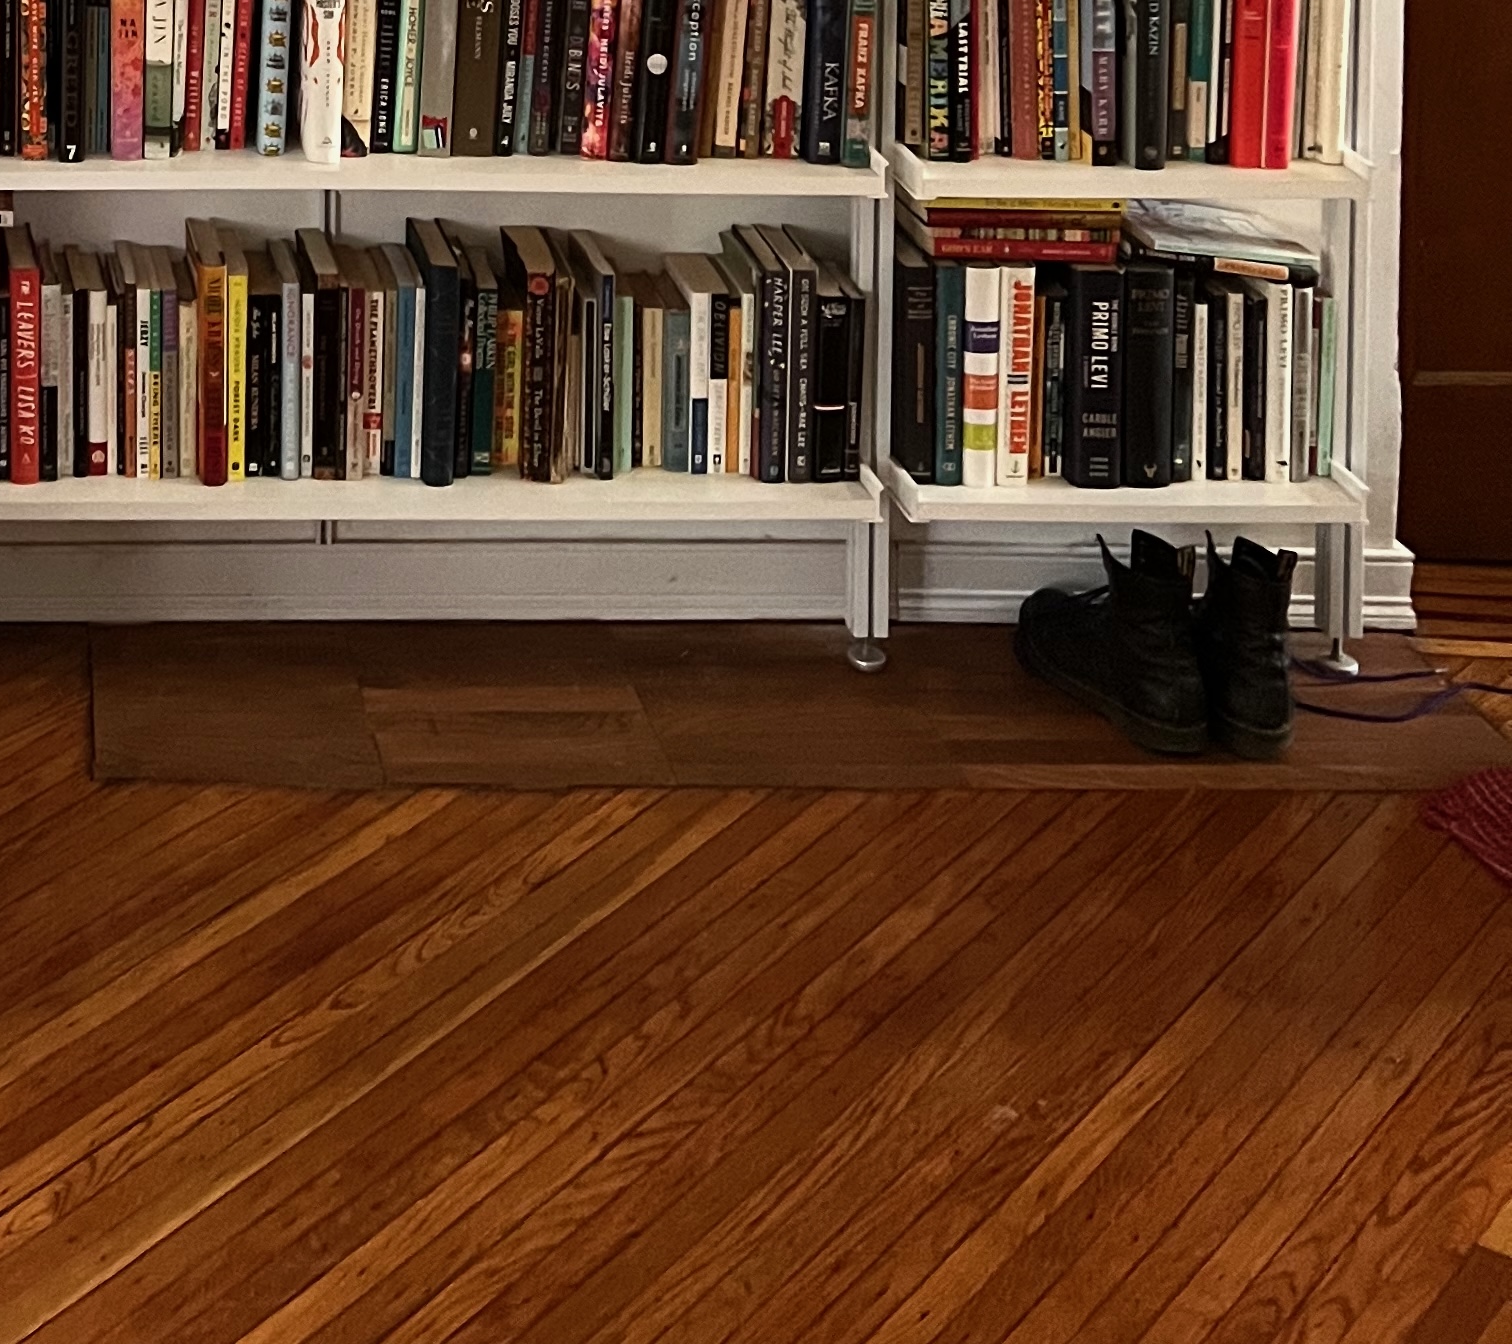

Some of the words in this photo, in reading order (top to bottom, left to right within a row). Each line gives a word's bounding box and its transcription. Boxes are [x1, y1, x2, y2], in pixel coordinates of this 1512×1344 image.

[1148, 13, 1159, 57] KAZIN
[822, 61, 840, 122] KAFKA
[855, 66, 868, 110] KAFKA
[286, 287, 296, 358] IGNORANCE
[770, 276, 783, 327] HARPER
[1012, 279, 1034, 372] JONATHAN
[1092, 301, 1110, 351] PRIMO
[17, 300, 35, 370] LEAVERS
[715, 300, 726, 375] OBLIVION
[1091, 353, 1108, 389] LEVI
[18, 386, 35, 414] LISA
[18, 422, 35, 446] KO
